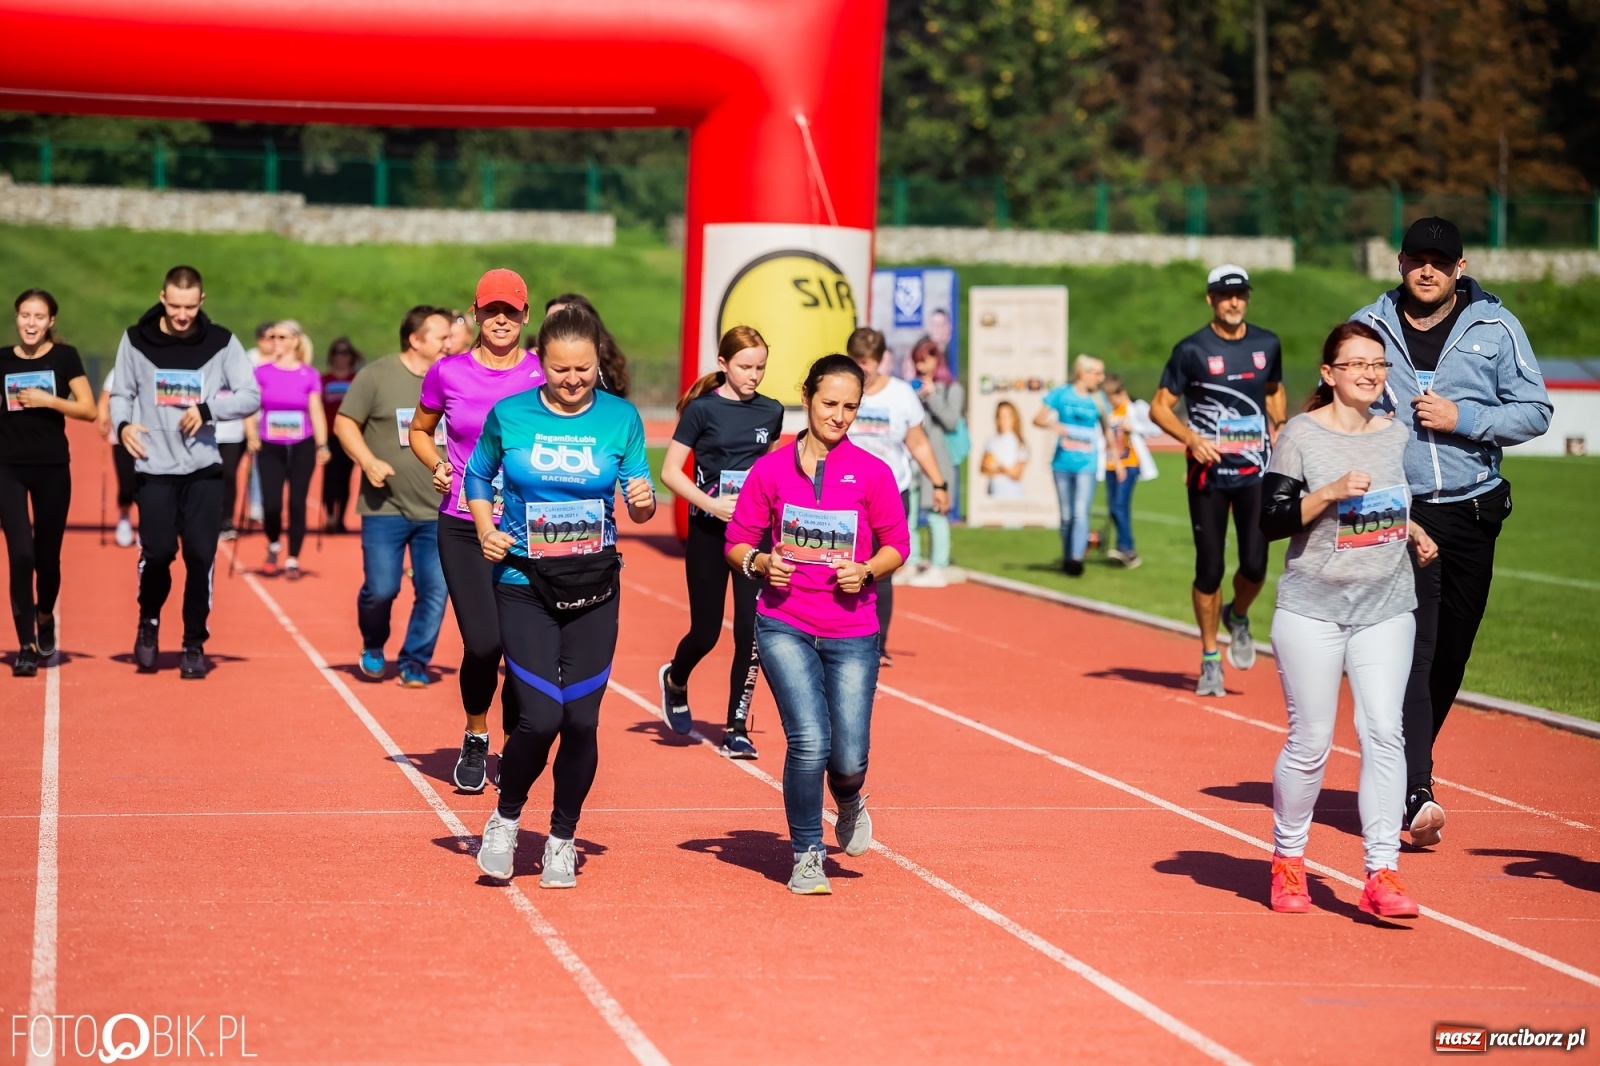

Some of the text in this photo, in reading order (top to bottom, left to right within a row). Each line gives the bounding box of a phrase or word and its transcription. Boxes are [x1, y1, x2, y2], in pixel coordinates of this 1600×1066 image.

[530, 443, 600, 476] bbl
[541, 475, 587, 485] RACIBÓRZ
[543, 520, 589, 544] 022
[1353, 507, 1394, 534] 035
[795, 526, 837, 549] 031
[556, 588, 612, 609] adidas
[744, 665, 759, 687] GIRL
